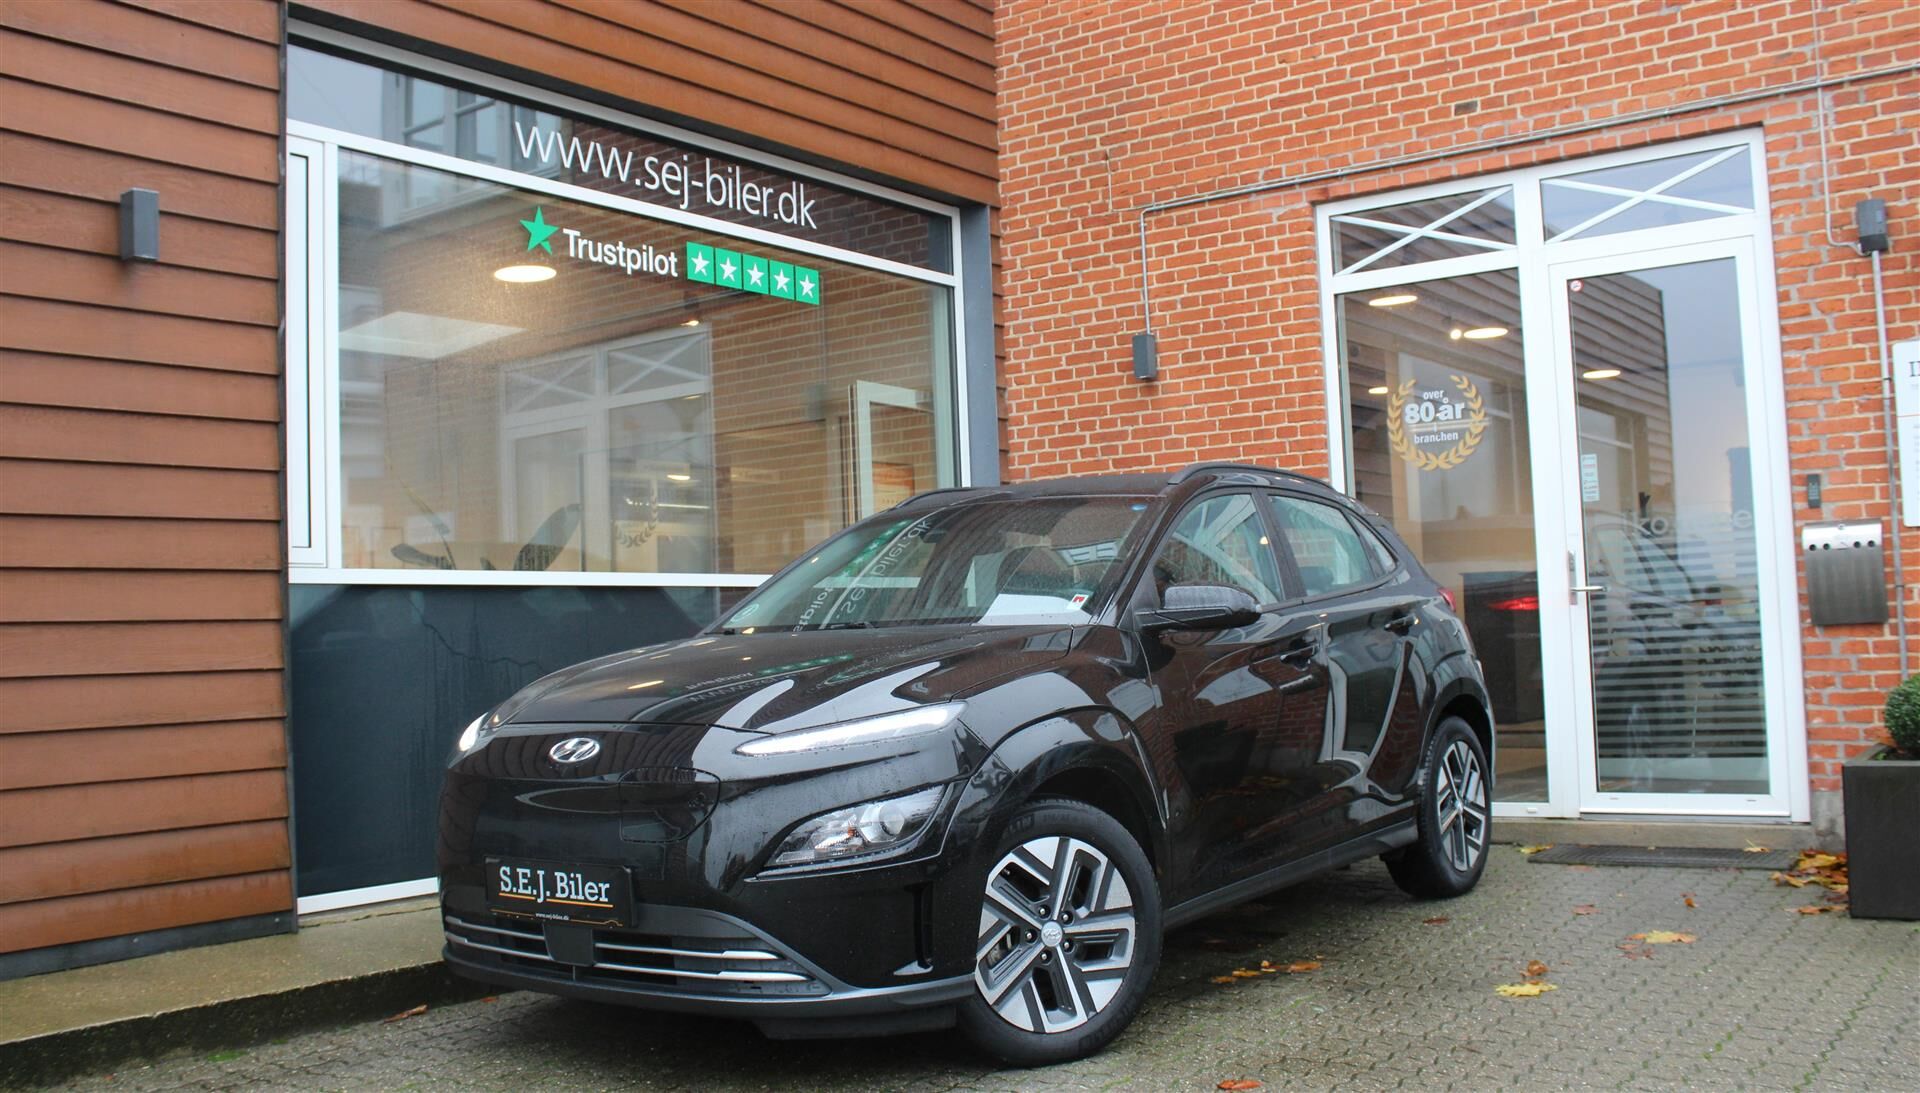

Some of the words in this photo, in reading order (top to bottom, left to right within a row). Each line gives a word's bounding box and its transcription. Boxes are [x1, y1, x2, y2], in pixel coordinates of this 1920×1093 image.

[515, 121, 818, 230] www.sej-biler.dk
[563, 228, 678, 278] Trustpilot
[1404, 401, 1435, 424] 80
[1438, 397, 1465, 420] år
[1423, 389, 1444, 400] over
[1414, 431, 1459, 444] branchen
[500, 866, 550, 903] S.E.J.
[554, 871, 610, 903] Biler
